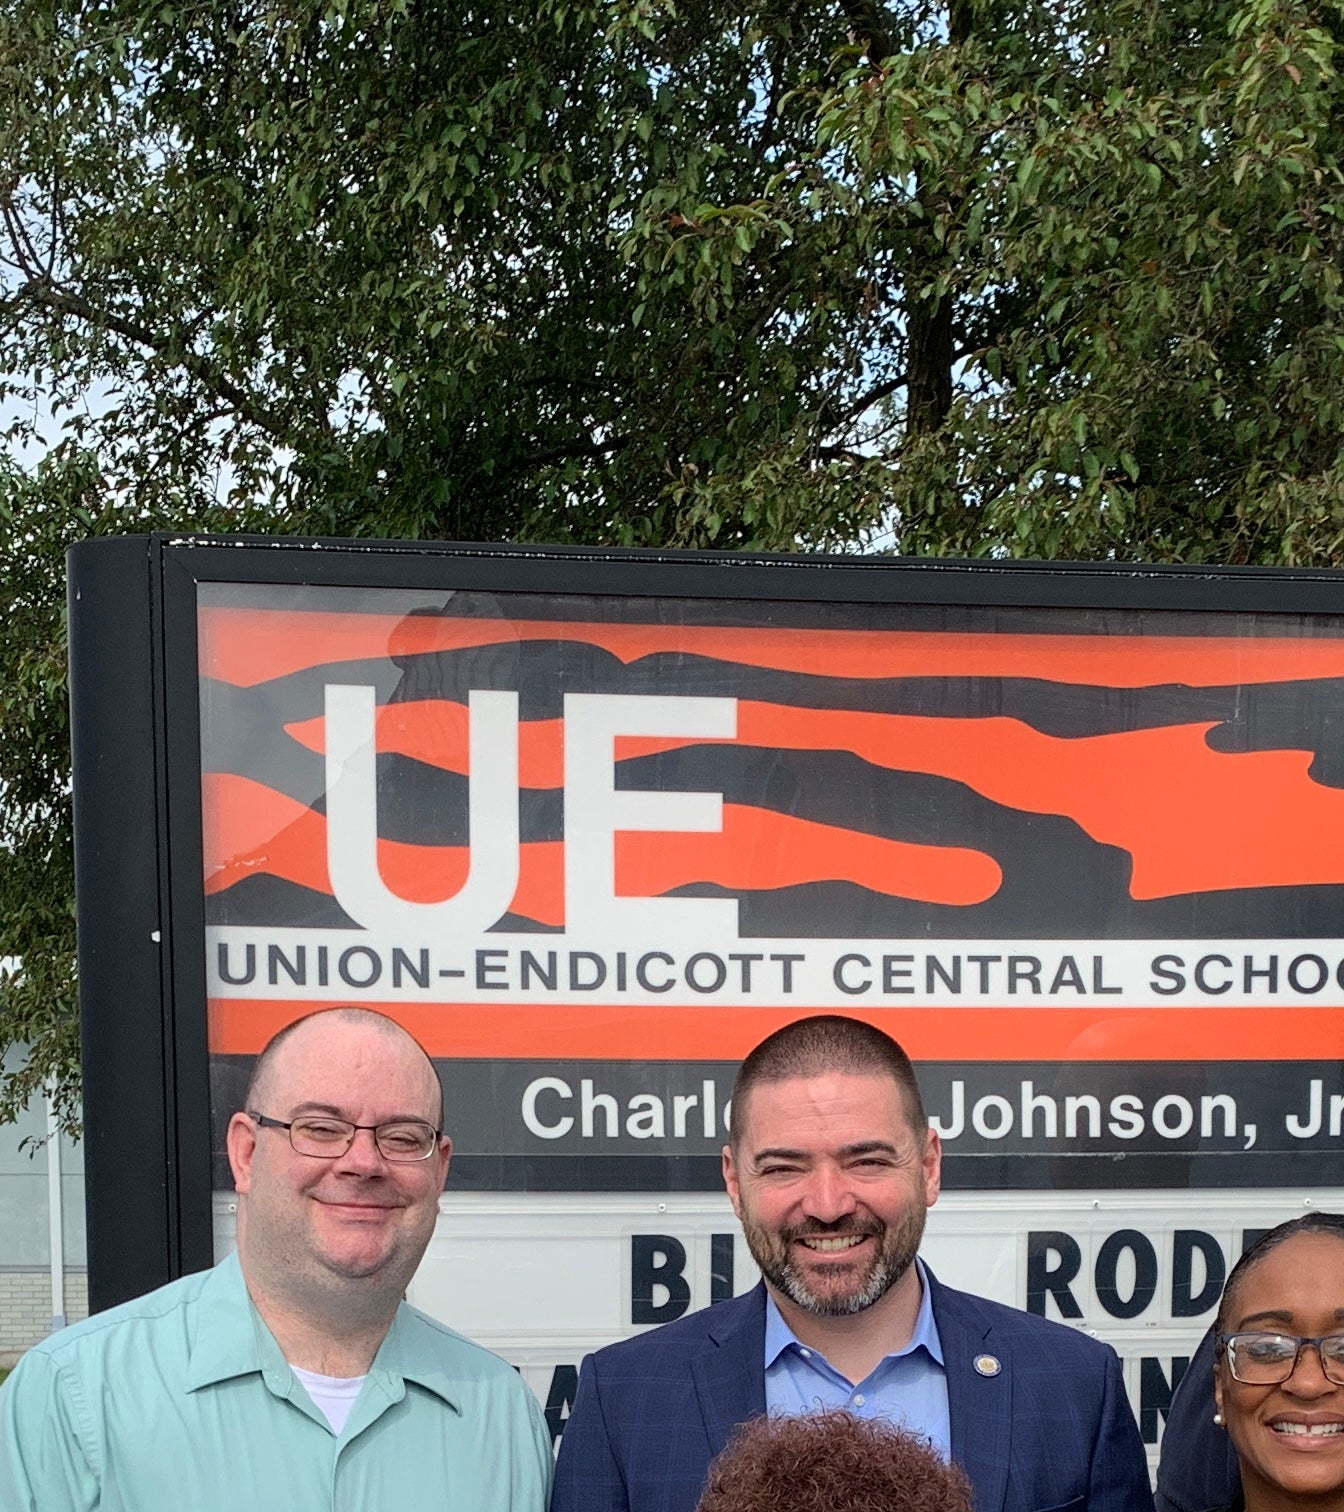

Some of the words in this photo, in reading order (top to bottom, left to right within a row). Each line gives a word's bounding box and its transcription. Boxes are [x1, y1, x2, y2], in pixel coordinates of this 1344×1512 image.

[324, 683, 739, 938] UE
[217, 942, 805, 995] UNION-ENDICOTT
[832, 952, 1123, 995] CENTRAL
[522, 1076, 734, 1140] Charl
[928, 1080, 1256, 1149] Johnson,
